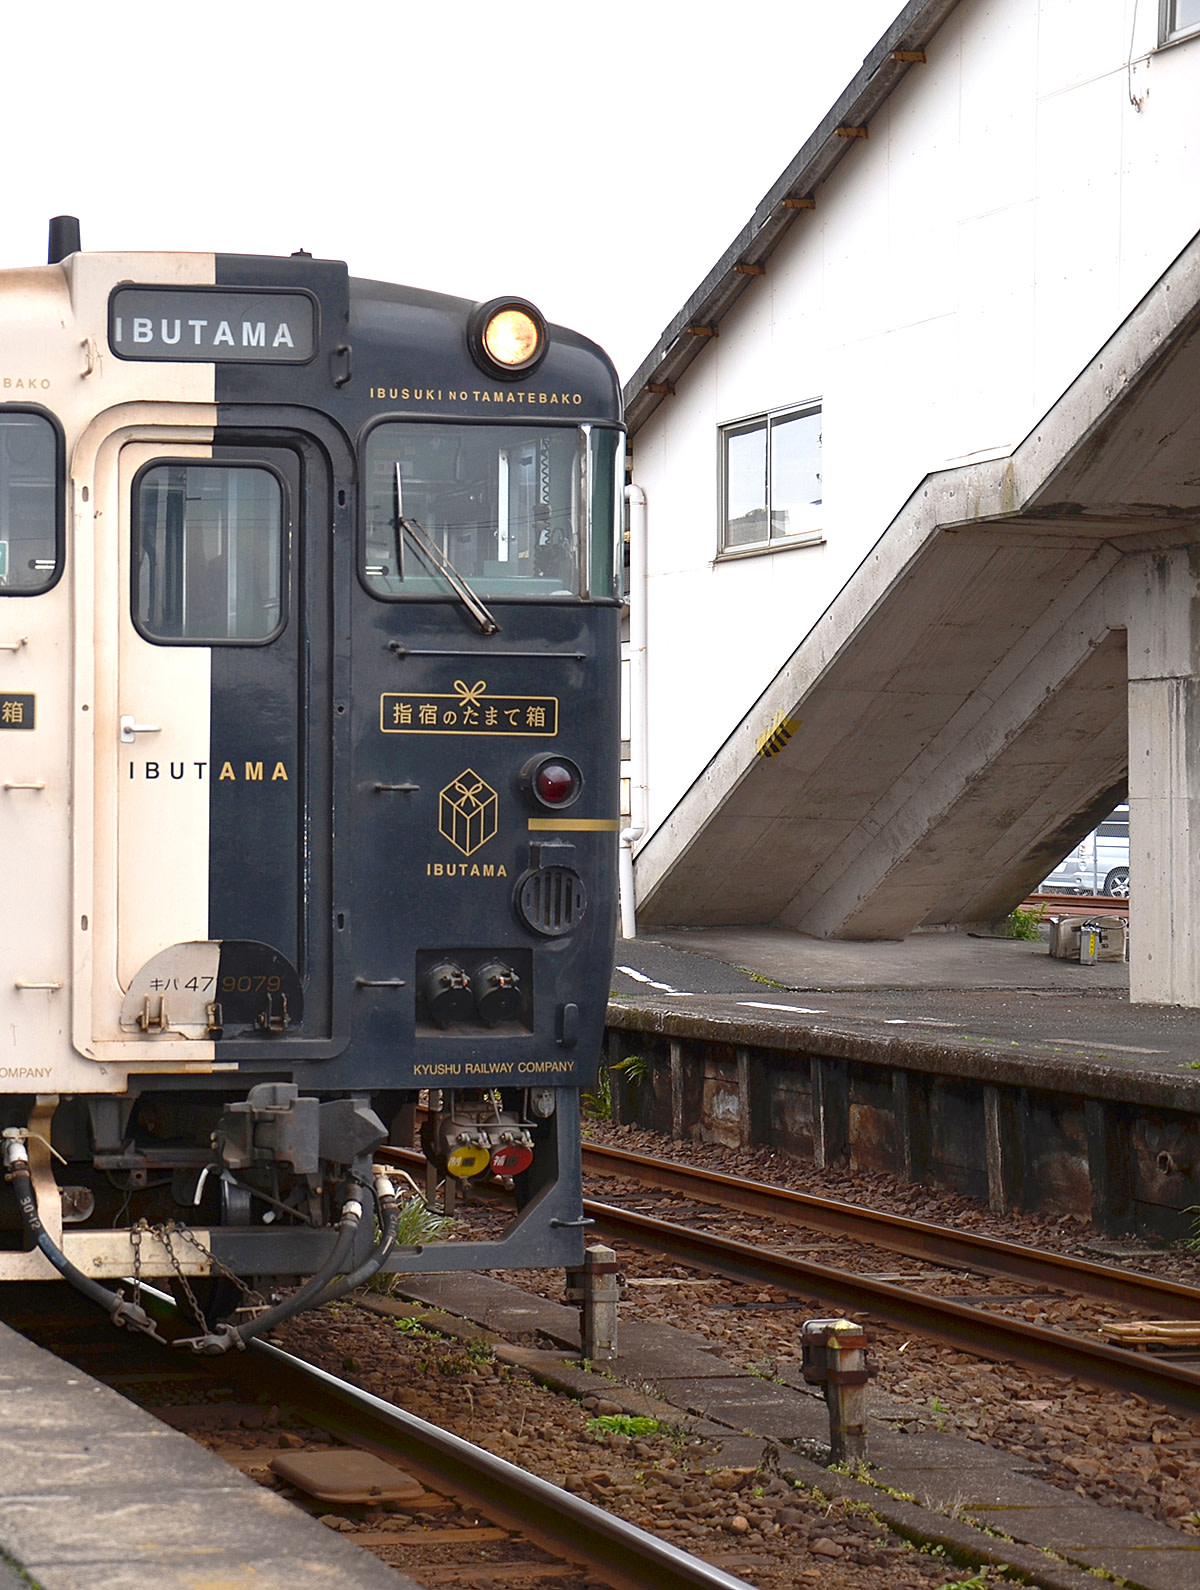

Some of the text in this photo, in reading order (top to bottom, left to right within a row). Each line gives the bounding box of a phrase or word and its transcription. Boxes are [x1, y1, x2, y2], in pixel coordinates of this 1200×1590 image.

[115, 317, 294, 347] IBUTAMA
[370, 388, 582, 405] IBUSUKI NO TAMATEBAKO
[393, 703, 546, 727] 指宿のたまて箱
[129, 761, 289, 780] IBUTAMA
[427, 863, 507, 877] IBUTAMA
[185, 976, 214, 992] 47
[221, 976, 281, 992] 9079
[413, 1061, 575, 1075] KYUSHU RAILWAY COMPANY
